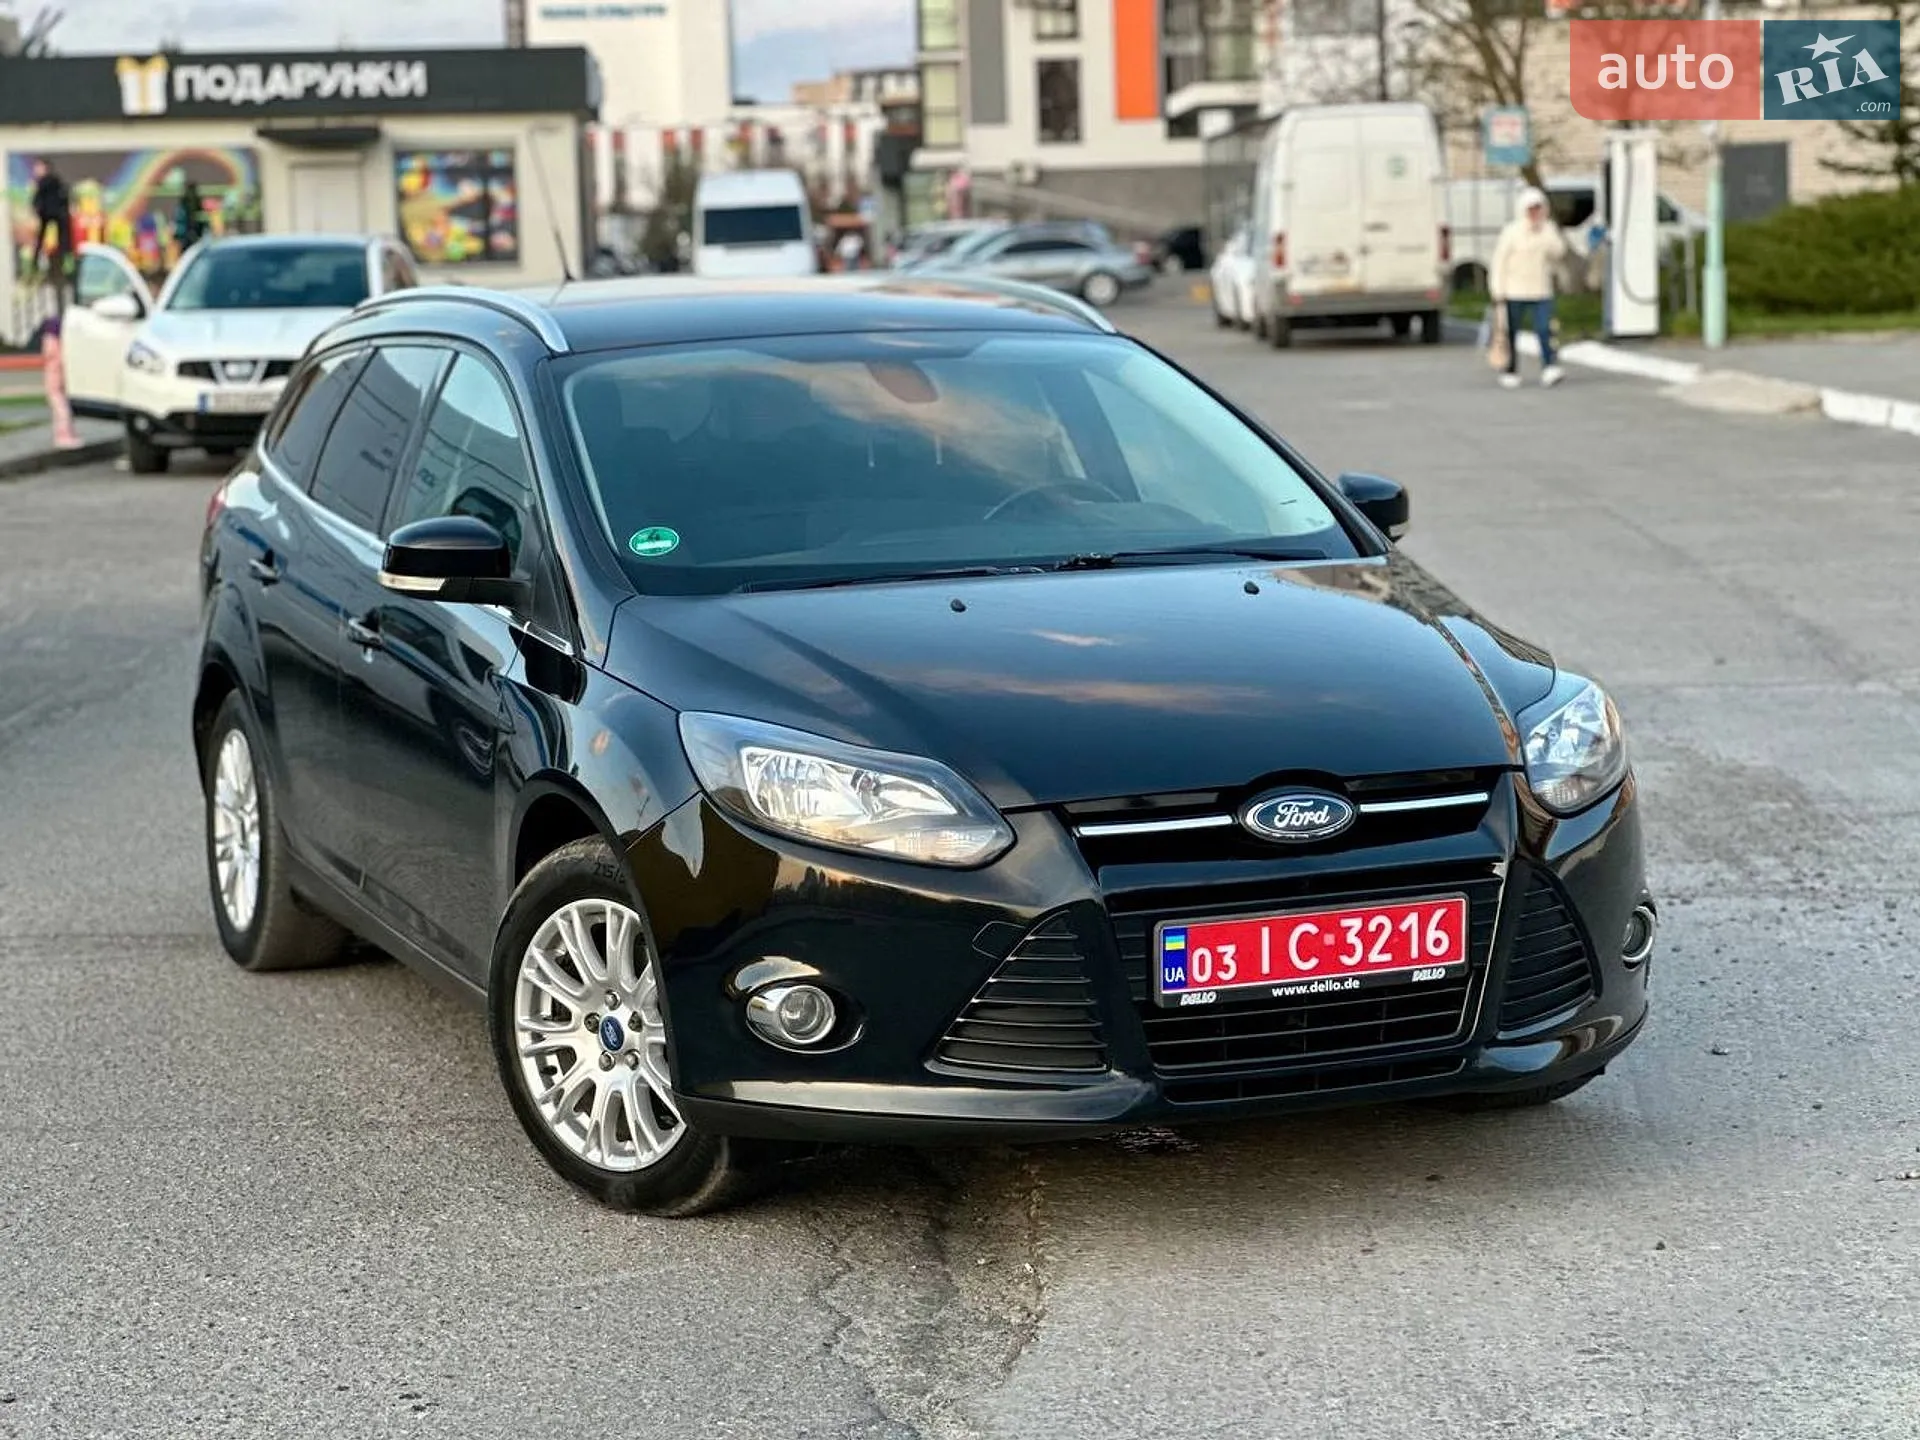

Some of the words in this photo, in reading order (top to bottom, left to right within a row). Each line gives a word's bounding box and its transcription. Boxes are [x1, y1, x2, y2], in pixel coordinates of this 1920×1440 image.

[173, 60, 428, 106] ПОДАРУНКИ
[1274, 800, 1330, 828] Ford
[1192, 944, 1238, 983] 03
[1339, 907, 1450, 967] 3216
[1164, 966, 1185, 983] UA
[1271, 977, 1361, 998] www.dello.de
